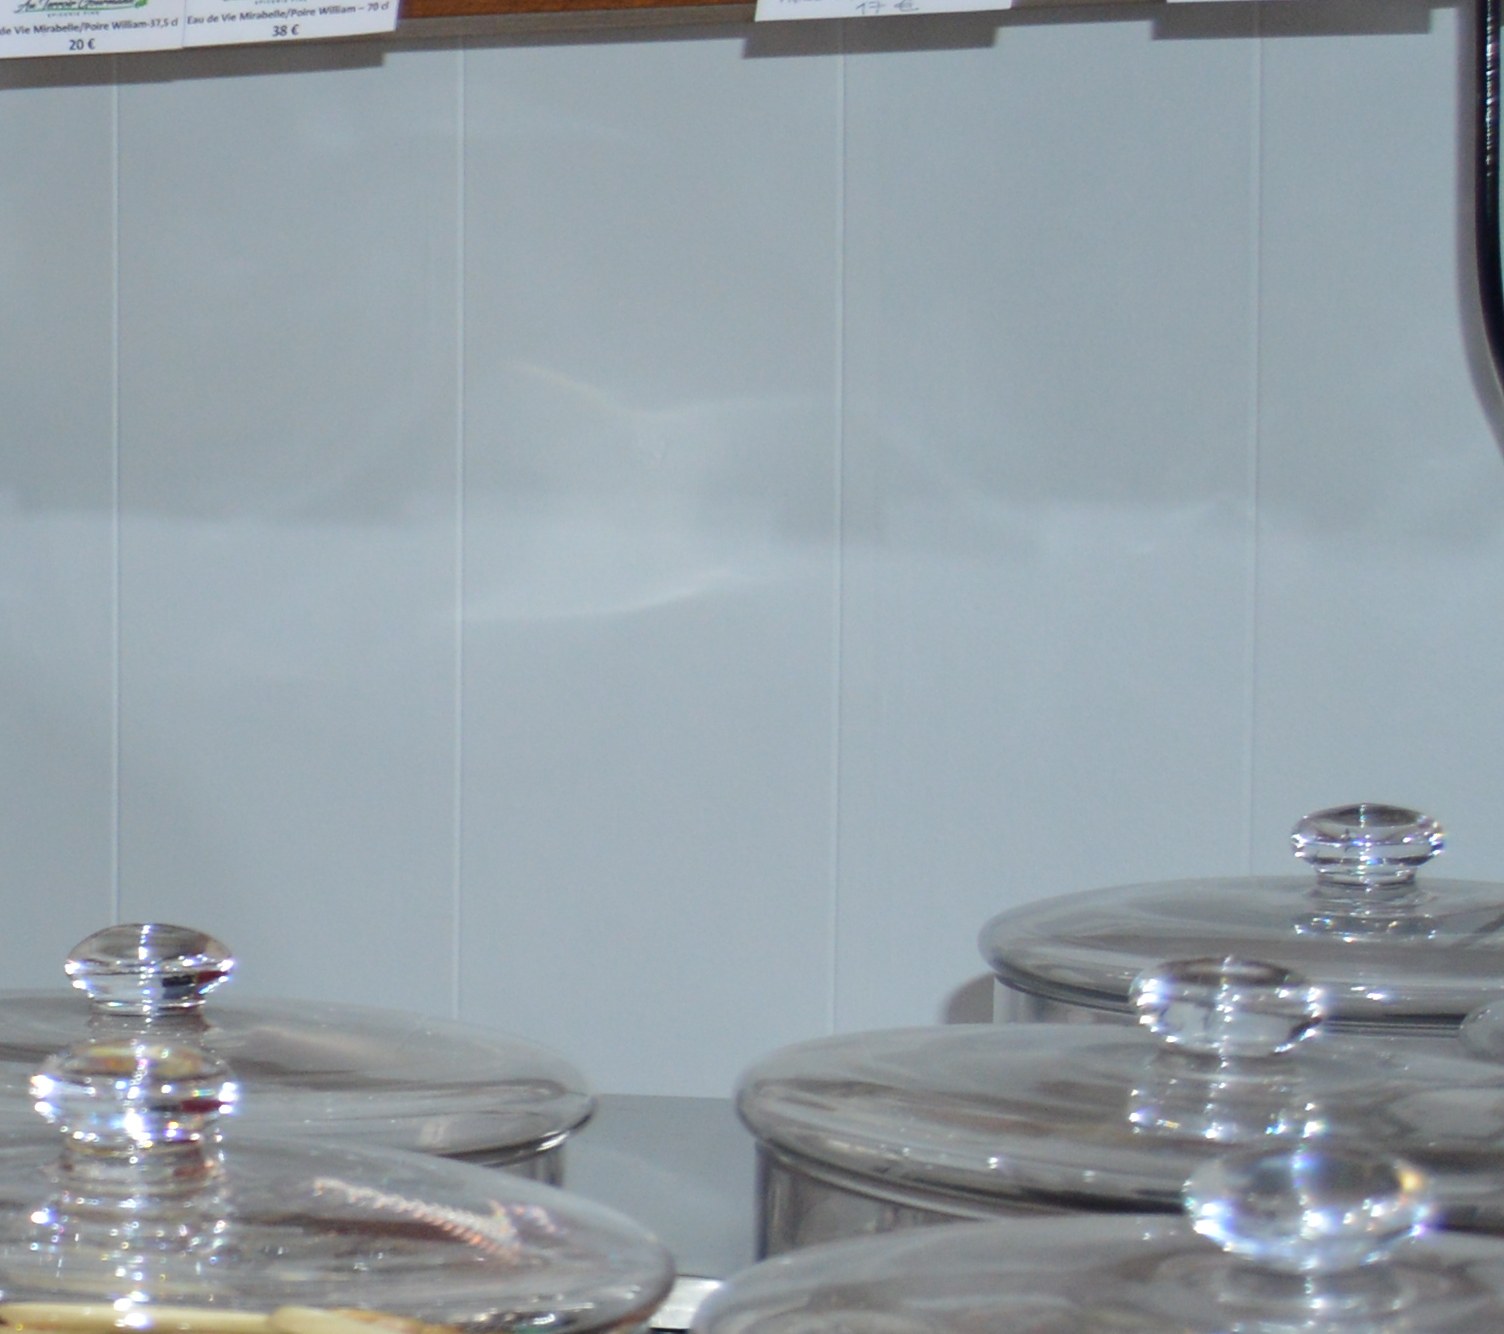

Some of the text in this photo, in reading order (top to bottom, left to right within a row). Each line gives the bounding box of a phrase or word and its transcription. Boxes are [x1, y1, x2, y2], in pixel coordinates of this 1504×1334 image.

[187, 15, 205, 25] Eau
[207, 13, 220, 23] de
[222, 12, 238, 22] Vie
[319, 3, 356, 16] William
[368, 2, 379, 12] 70
[856, 1, 920, 15] 17 €
[0, 27, 11, 37] de
[14, 26, 30, 36] Vie
[272, 24, 300, 37] 38 €
[69, 38, 95, 50] 20 €
